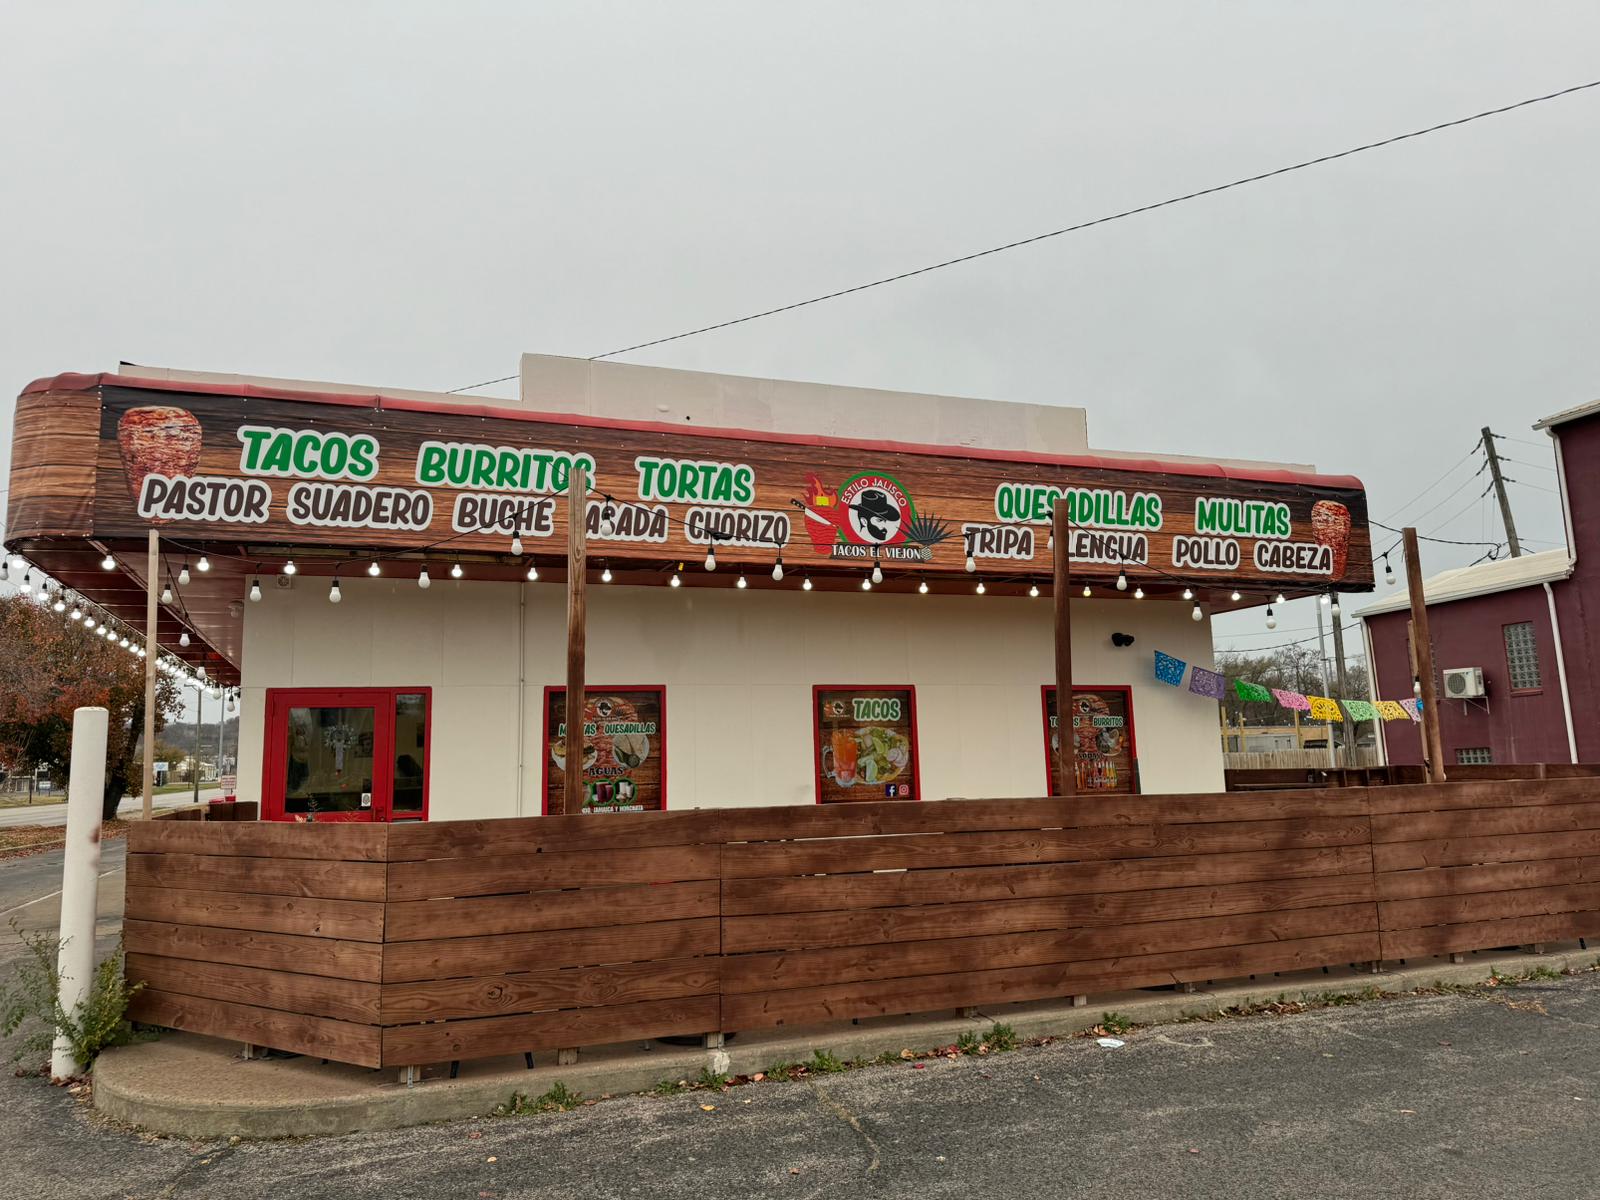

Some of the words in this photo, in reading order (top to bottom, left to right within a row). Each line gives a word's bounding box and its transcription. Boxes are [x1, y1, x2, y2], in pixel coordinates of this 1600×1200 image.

[243, 430, 374, 477] TACOS
[420, 446, 593, 491] BURRITOS
[639, 460, 752, 503] TORTAS
[841, 478, 869, 504] ESTILO
[871, 478, 907, 507] JALISCO
[143, 479, 268, 519] PASTOR
[292, 488, 430, 526] SUADERO
[457, 497, 553, 532] BUCHE
[586, 504, 666, 538] ASADA
[689, 511, 788, 544] CHORIZO
[1197, 500, 1290, 536] MULITAS
[831, 544, 866, 557] TACOS
[869, 547, 883, 558] EL
[885, 547, 922, 560] VIEJON
[966, 527, 1032, 556] TRIPA
[1068, 532, 1146, 561] ENGUA
[1176, 539, 1239, 566] POLLO
[1257, 545, 1332, 571] CABEZA
[853, 699, 900, 719] TACOS
[604, 721, 656, 735] QUESADILLAS
[1093, 716, 1124, 727] BURRITOS
[588, 767, 624, 776] AGUAS
